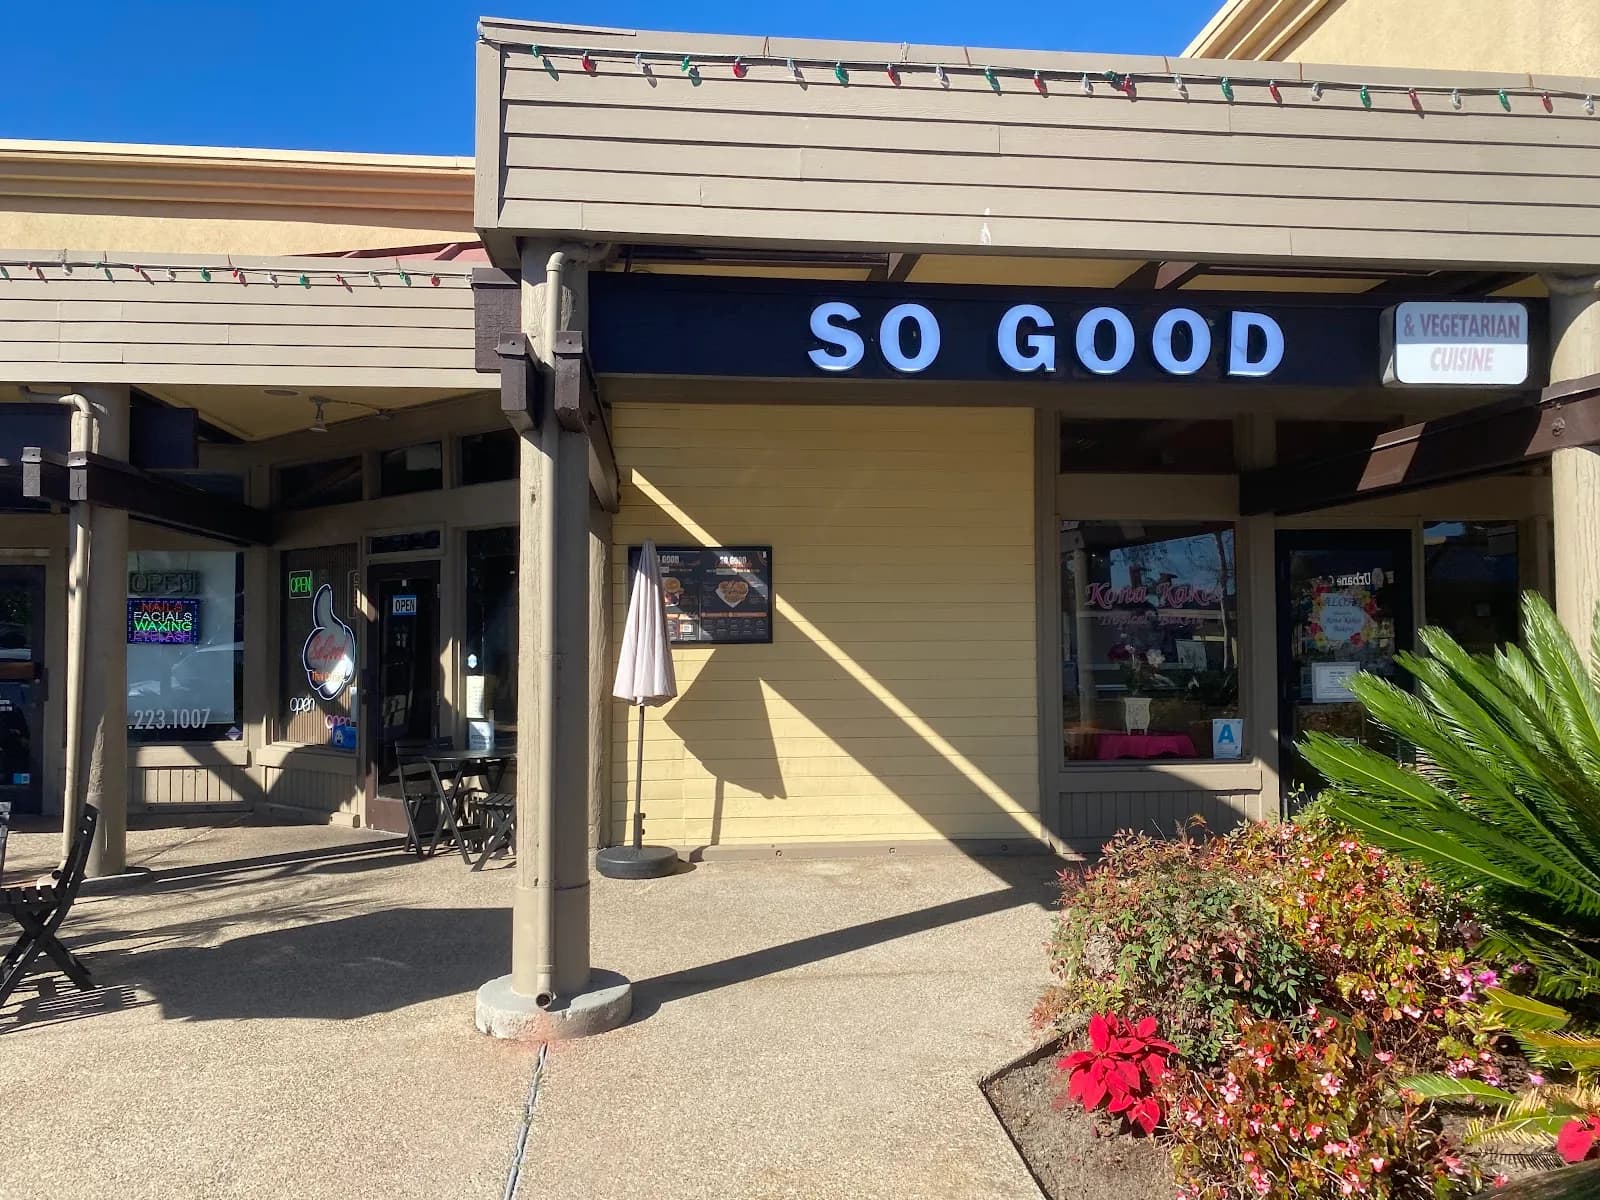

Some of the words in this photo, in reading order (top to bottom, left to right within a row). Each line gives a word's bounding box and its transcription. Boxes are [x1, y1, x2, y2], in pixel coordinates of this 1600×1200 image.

[1404, 313, 1415, 337] &
[1420, 313, 1520, 338] VEGETARIAN
[807, 301, 941, 372] SO
[997, 303, 1285, 378] GOOD
[1430, 347, 1494, 371] CUISINE
[131, 573, 196, 593] OPEN
[290, 577, 311, 593] OPEN
[395, 599, 415, 612] OPEN
[1086, 582, 1148, 609] Kona
[133, 611, 192, 621] FACIALS
[134, 621, 192, 631] WAXING
[289, 697, 315, 715] open
[1217, 723, 1235, 744] A
